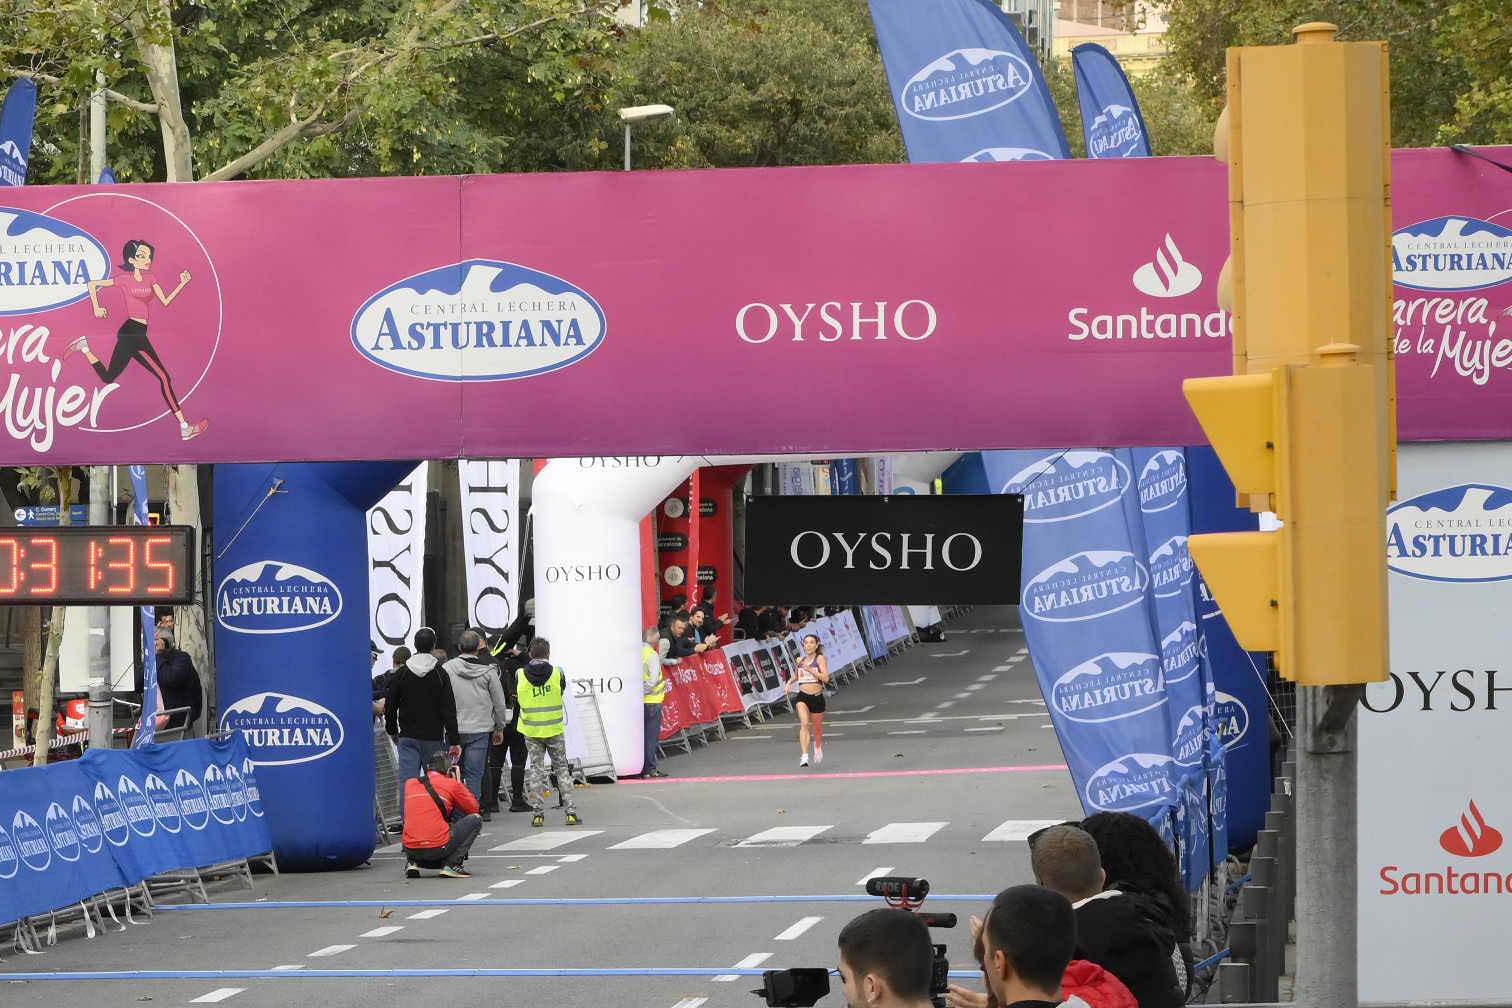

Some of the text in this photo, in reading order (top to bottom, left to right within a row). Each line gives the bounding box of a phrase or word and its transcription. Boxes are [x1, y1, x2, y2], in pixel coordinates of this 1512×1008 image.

[14, 243, 86, 254] LECHERA
[1407, 240, 1459, 250] CENTRAL
[410, 300, 578, 316] CENTRAL LECHERA
[1393, 297, 1489, 326] arrera
[371, 306, 586, 352] ASTURIANA
[735, 299, 937, 344] OYSHO
[1417, 326, 1435, 354] la
[1430, 321, 1512, 386] Muje
[1414, 519, 1481, 529] CENTRAL
[790, 530, 983, 571] OYSHO
[546, 563, 622, 584] OYSHO
[233, 585, 329, 595] CENTRAL LECHERA
[221, 590, 333, 618] ASTURIANA
[532, 684, 552, 698] Life
[576, 677, 623, 696] SHO
[1360, 669, 1512, 713] OYSH
[235, 717, 329, 726] CENTRAL LECHERA
[225, 721, 334, 747] TURIANA
